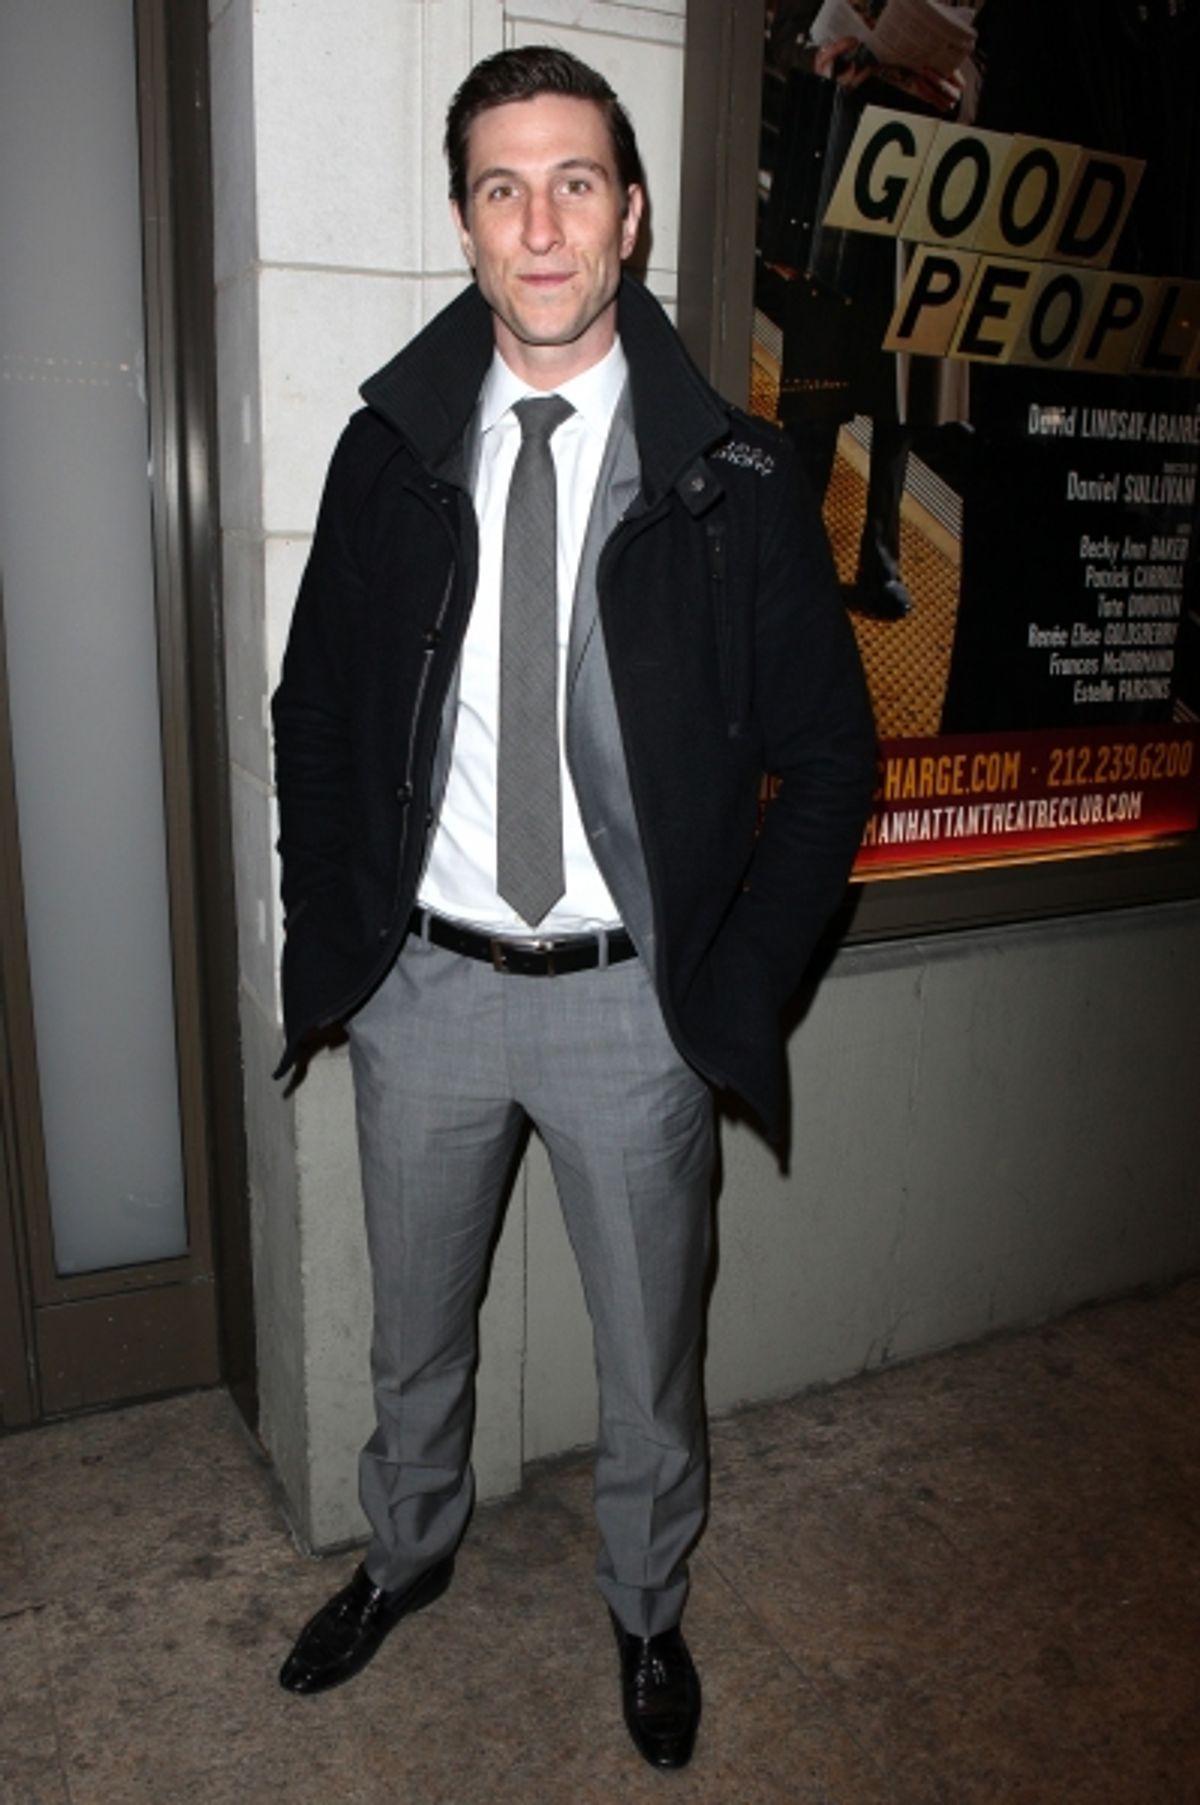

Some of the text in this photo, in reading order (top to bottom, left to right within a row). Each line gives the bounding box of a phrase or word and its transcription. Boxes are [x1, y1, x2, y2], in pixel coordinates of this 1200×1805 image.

[854, 121, 1125, 256] GOOD
[897, 256, 1200, 370] PEOPL
[1067, 470, 1197, 505] Daniel SULLIVAN
[1080, 535, 1121, 564] Becky
[1045, 739, 1194, 788] 212.239.6200
